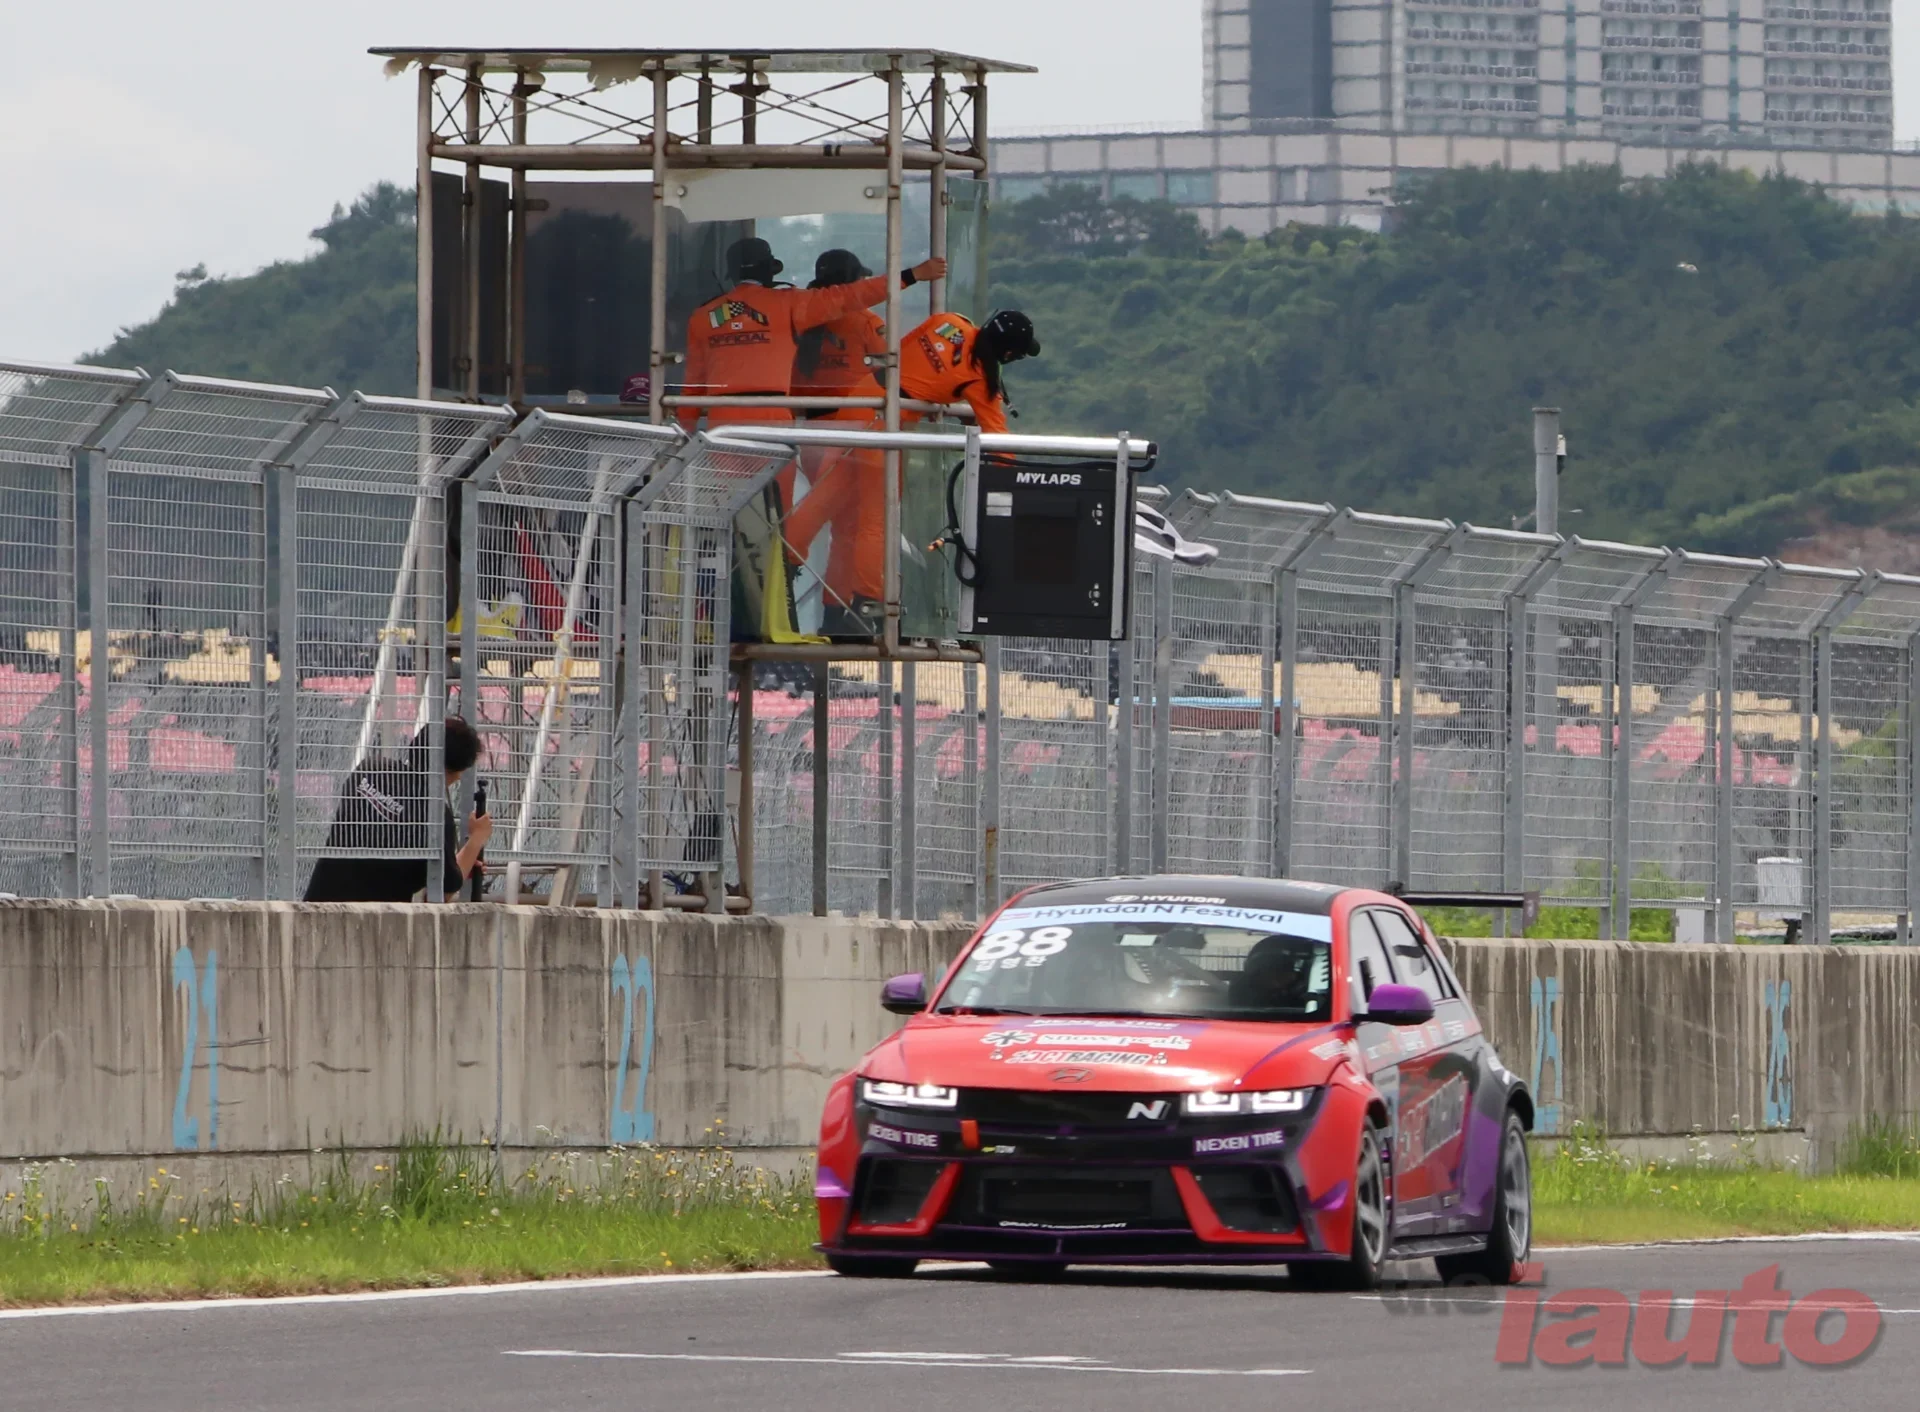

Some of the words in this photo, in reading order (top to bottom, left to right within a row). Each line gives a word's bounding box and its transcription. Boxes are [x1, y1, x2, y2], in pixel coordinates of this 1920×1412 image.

[1016, 472, 1081, 485] MYLAPS
[1142, 895, 1227, 904] HYUNDAI
[1034, 904, 1147, 919] Hyundai
[1152, 904, 1172, 914] N
[1181, 906, 1283, 924] Festival
[971, 927, 1073, 961] 88
[173, 945, 217, 1149] 21
[611, 952, 655, 1143] 22
[903, 1131, 938, 1147] TIRE
[1196, 1135, 1249, 1152] NEXEN
[1251, 1130, 1284, 1147] TIRE
